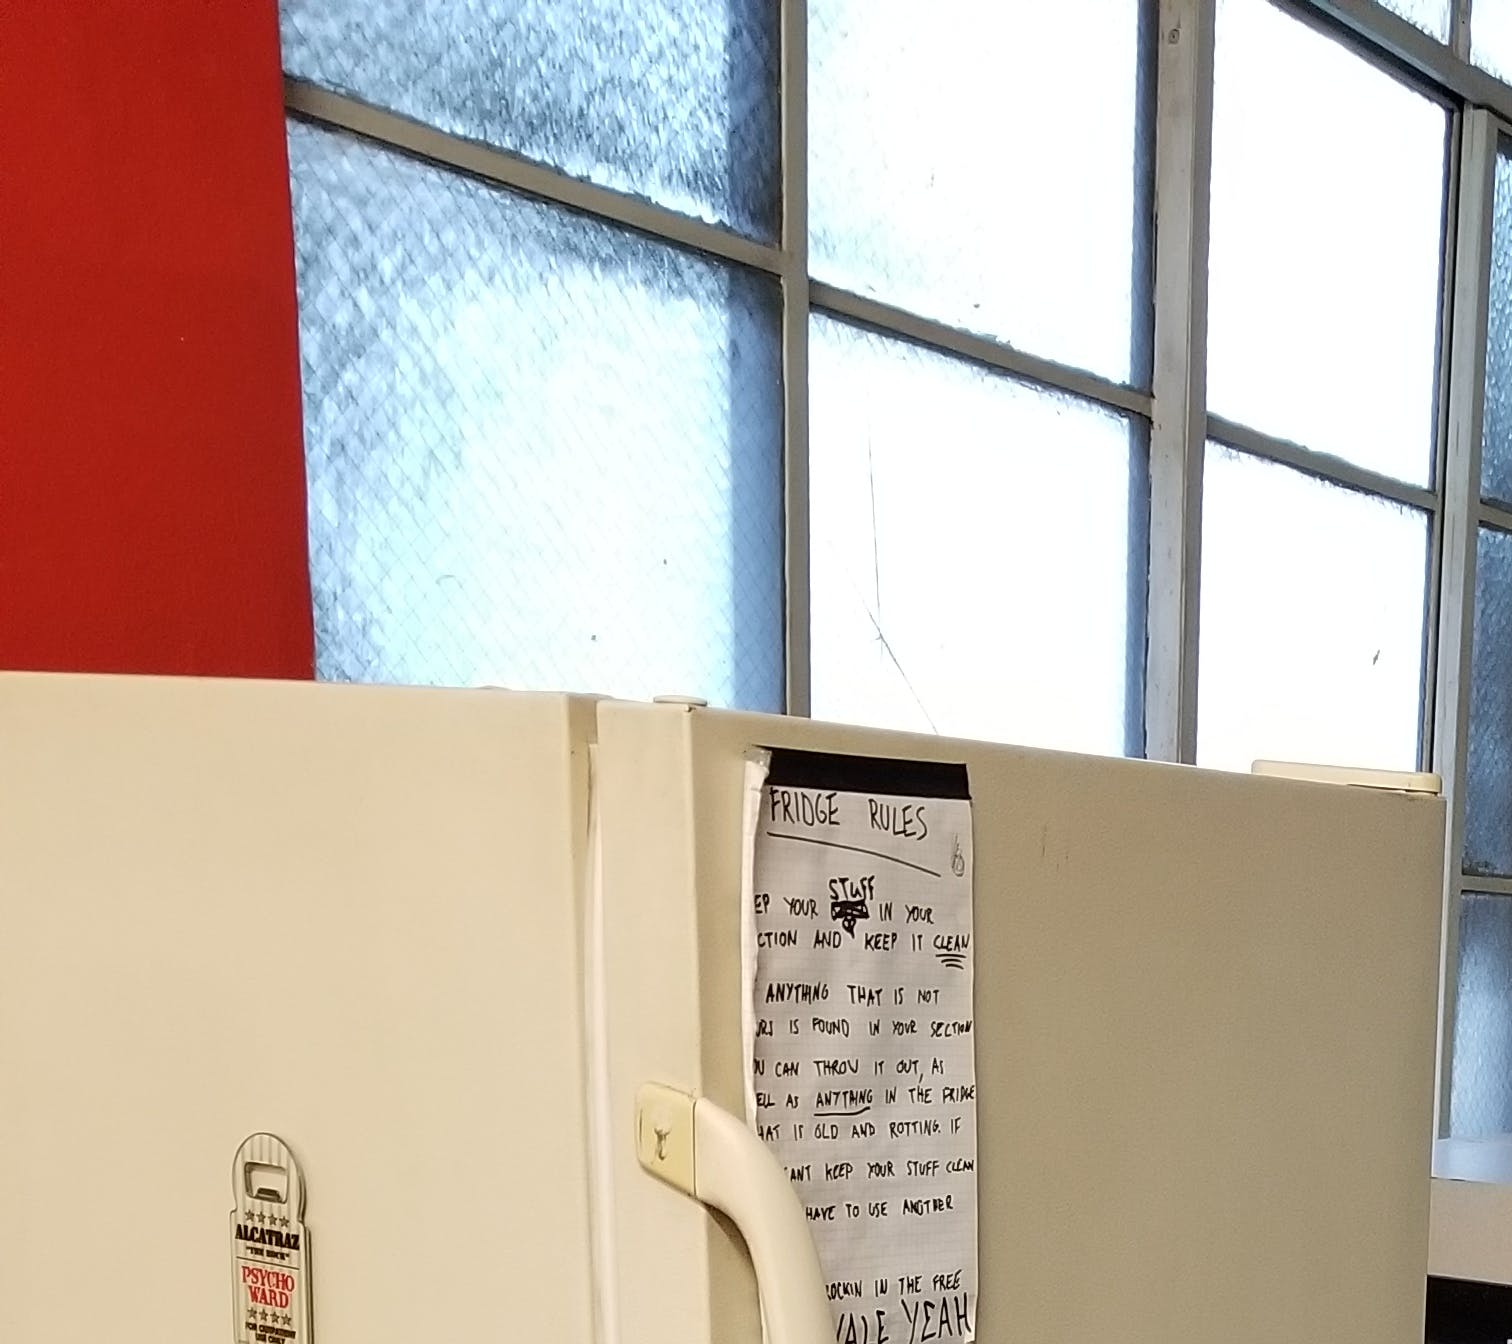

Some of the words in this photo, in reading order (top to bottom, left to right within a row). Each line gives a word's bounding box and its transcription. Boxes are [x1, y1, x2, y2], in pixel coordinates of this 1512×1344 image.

[769, 786, 841, 827] FRIDGE
[867, 798, 928, 841] RULES
[783, 897, 818, 917] YOUR
[879, 902, 893, 922] IN
[905, 904, 934, 925] YOUR
[813, 929, 842, 949] AND
[864, 931, 898, 952] KEEP
[912, 933, 923, 952] IT
[933, 933, 970, 952] CLEAN
[765, 981, 829, 1005] ANYTHING
[847, 984, 883, 1007] THAT
[894, 986, 904, 1006] IS
[917, 988, 940, 1006] NOT
[789, 1018, 800, 1035] IS
[812, 1017, 850, 1038] FOUND
[869, 1019, 880, 1036] IN
[892, 1019, 918, 1036] YOUR
[930, 1019, 973, 1038] SECTION
[775, 1061, 800, 1078] CAN
[874, 1060, 885, 1076] IT
[932, 1057, 944, 1076] AS
[786, 1093, 800, 1109] AS
[885, 1086, 897, 1104] IN
[908, 1086, 933, 1105] THE
[814, 1121, 839, 1140] OLD
[851, 1121, 876, 1139] AND
[950, 1116, 961, 1134] IF
[825, 1162, 853, 1181] KEEP
[867, 1160, 896, 1180] YOUR
[906, 1160, 940, 1178] STUFF
[945, 1158, 975, 1174] CLEAN
[805, 1204, 836, 1221] HAVE
[845, 1203, 860, 1219] TO
[868, 1201, 888, 1218] USE
[235, 1223, 300, 1251] ALCATRAZ
[241, 1265, 295, 1292] PSYCHO
[874, 1278, 888, 1298] IN
[898, 1275, 922, 1295] THE
[932, 1269, 962, 1292] FREE
[248, 1285, 289, 1309] WARD
